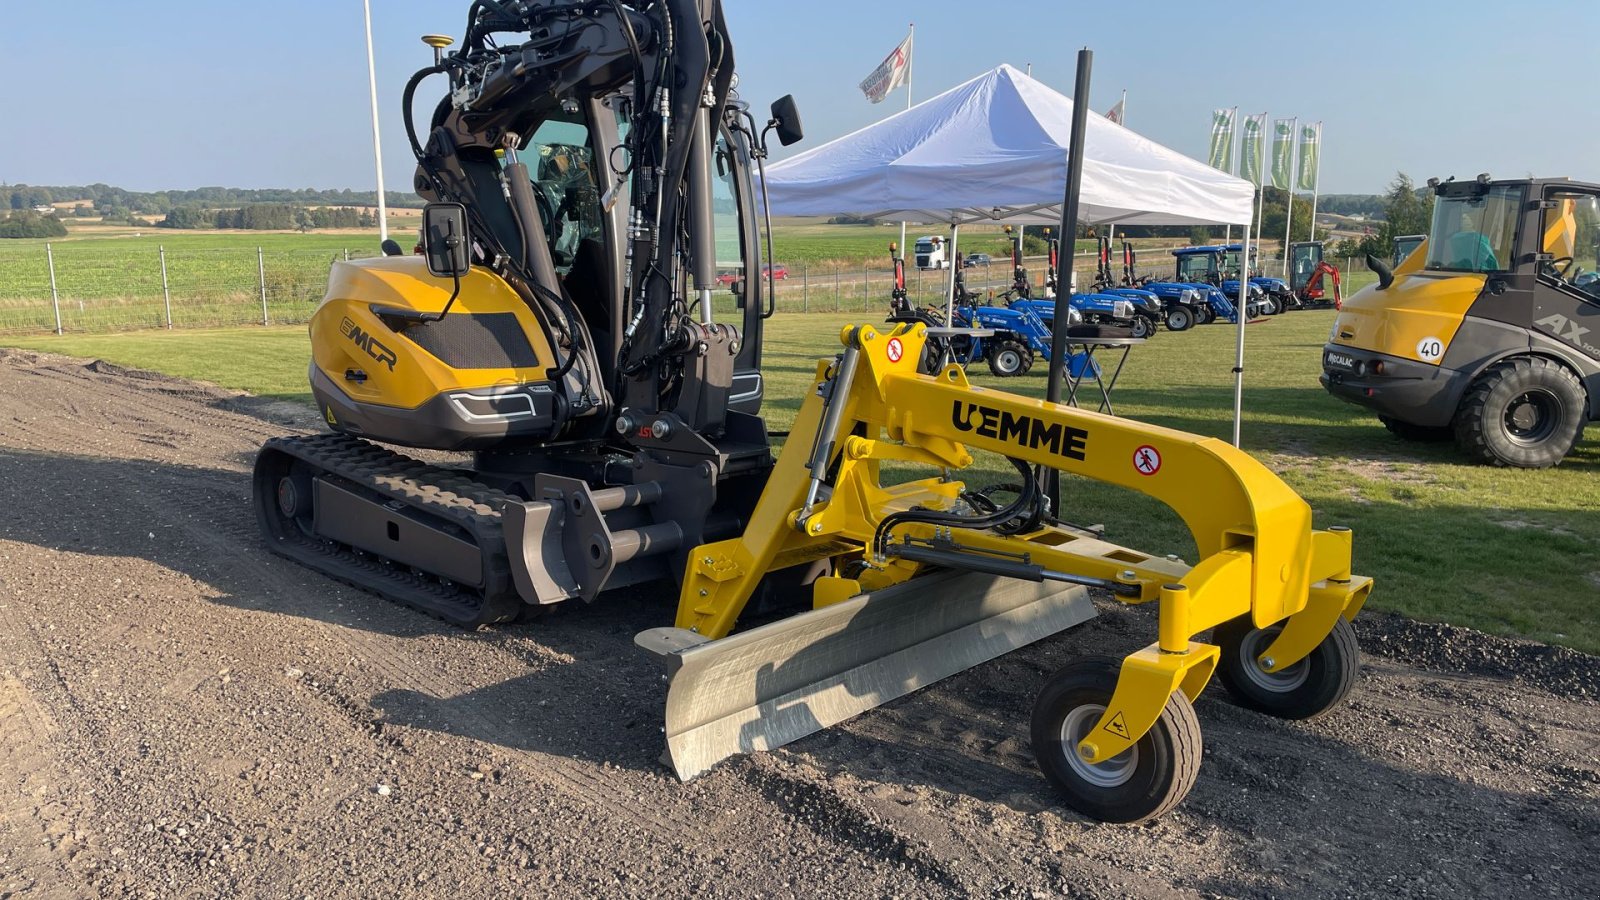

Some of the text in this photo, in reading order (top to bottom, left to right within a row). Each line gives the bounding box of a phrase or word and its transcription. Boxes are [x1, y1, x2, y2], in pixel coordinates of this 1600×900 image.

[1421, 342, 1440, 356] 40
[1534, 314, 1600, 357] AX 100
